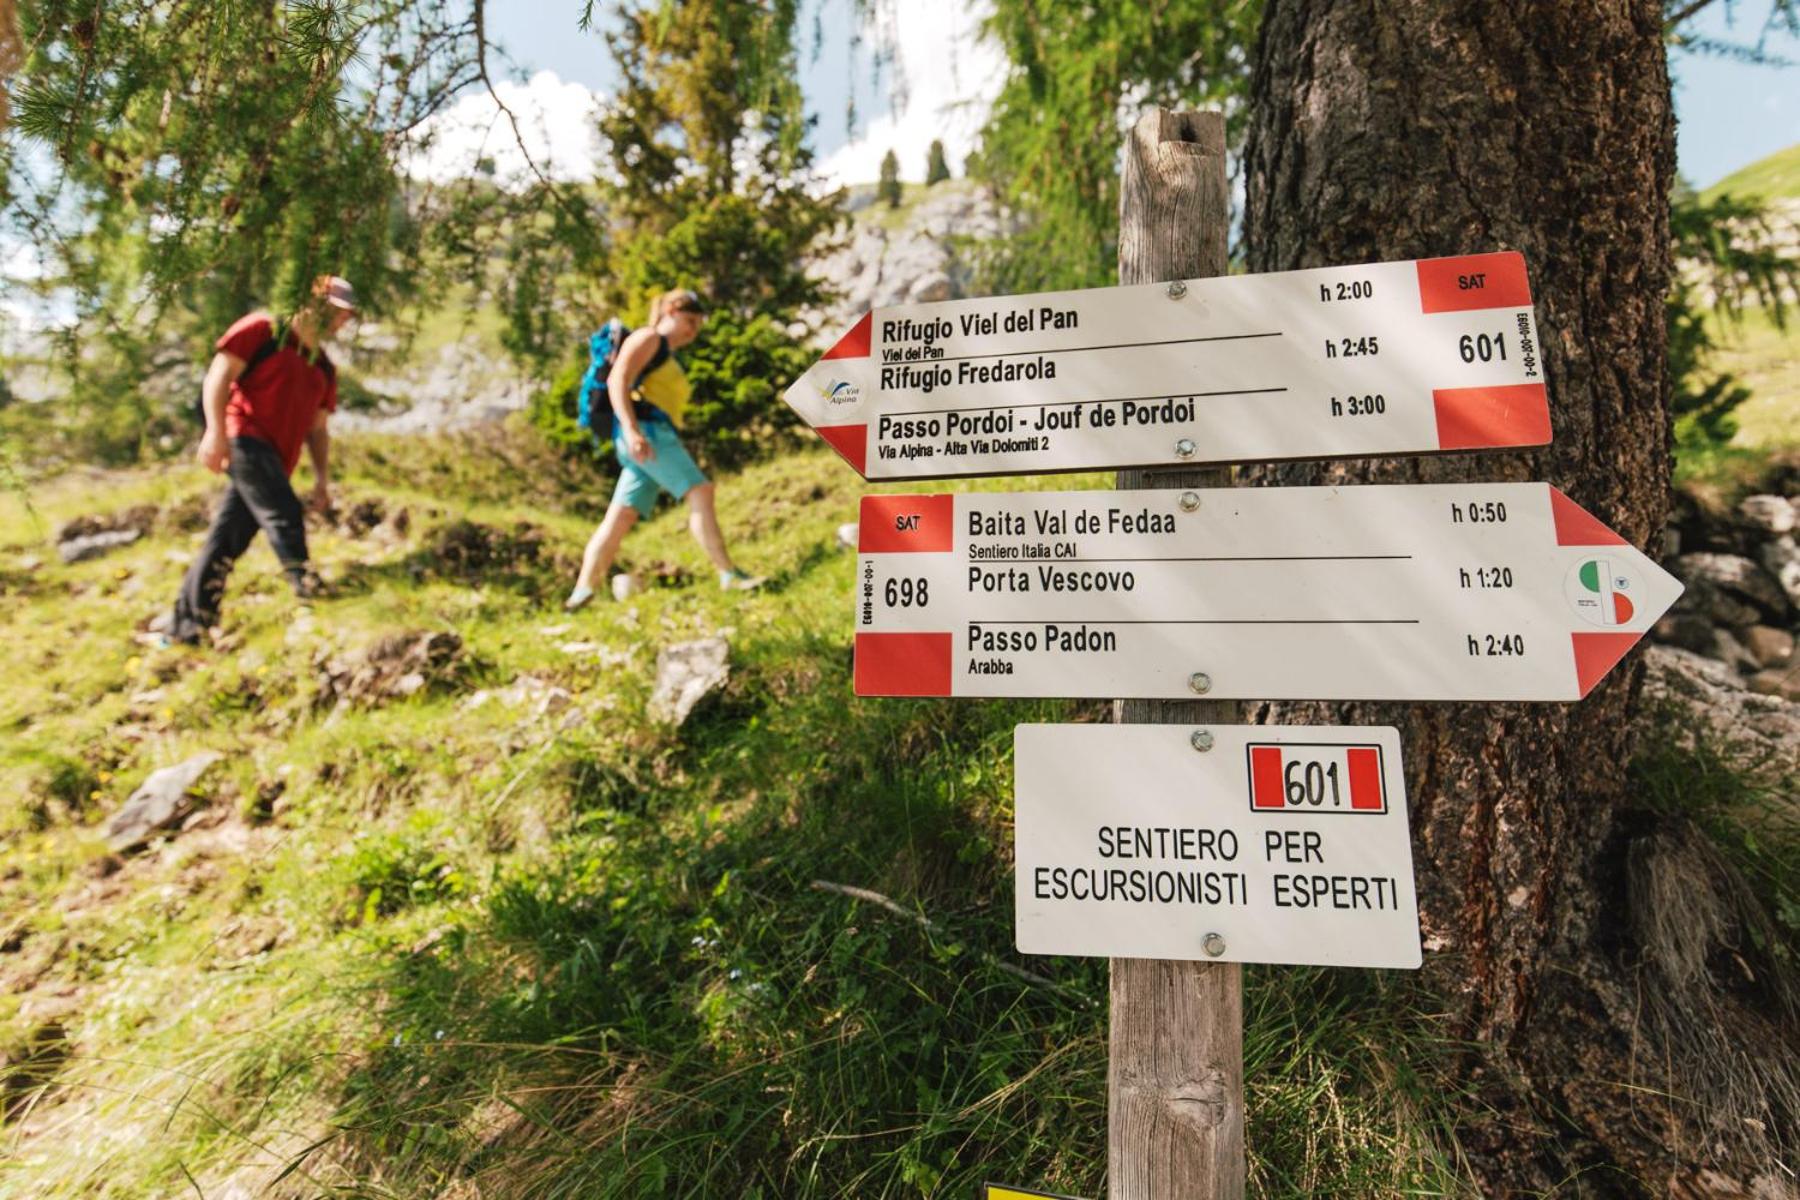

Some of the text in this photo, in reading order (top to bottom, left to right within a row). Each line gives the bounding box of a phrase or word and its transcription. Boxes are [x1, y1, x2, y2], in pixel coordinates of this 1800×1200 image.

[1320, 280, 1373, 302] h 2:00
[1458, 274, 1486, 290] SAT
[883, 308, 1078, 344] Rifugio Viel del Pan
[882, 346, 944, 361] Viel del Pan
[1326, 337, 1379, 358] h 2:45
[1459, 332, 1507, 363] 601
[880, 356, 1056, 392] Rifugio Fredarola
[1332, 394, 1385, 416] h 3:00
[879, 416, 940, 440] Passo
[947, 409, 1013, 436] Pordoi
[1034, 404, 1082, 431] Jouf
[1089, 404, 1116, 428] de
[1123, 398, 1195, 425] Pordoi
[878, 445, 896, 459] Via
[900, 444, 933, 460] Alpina
[944, 442, 967, 456] Alta
[971, 440, 990, 454] Via
[992, 437, 1038, 453] Dolomiti
[1041, 436, 1049, 450] 2
[895, 515, 920, 531] SAT
[968, 508, 1176, 536] Baita Val de Fedaa
[1452, 502, 1507, 523] h 0:50
[968, 543, 1077, 559] Sentiero Italia CAI
[968, 566, 1135, 592] Porta Vescovo
[1459, 567, 1513, 588] h 1:20
[885, 577, 929, 608] 698
[968, 625, 1117, 652] Passo Padon
[1468, 635, 1524, 656] h 2:40
[968, 658, 1013, 675] Arabba
[1284, 760, 1341, 807] 601
[1098, 826, 1324, 864] SENTIERO PER
[1035, 867, 1398, 911] ESCURSIONISTI ESPERTI
